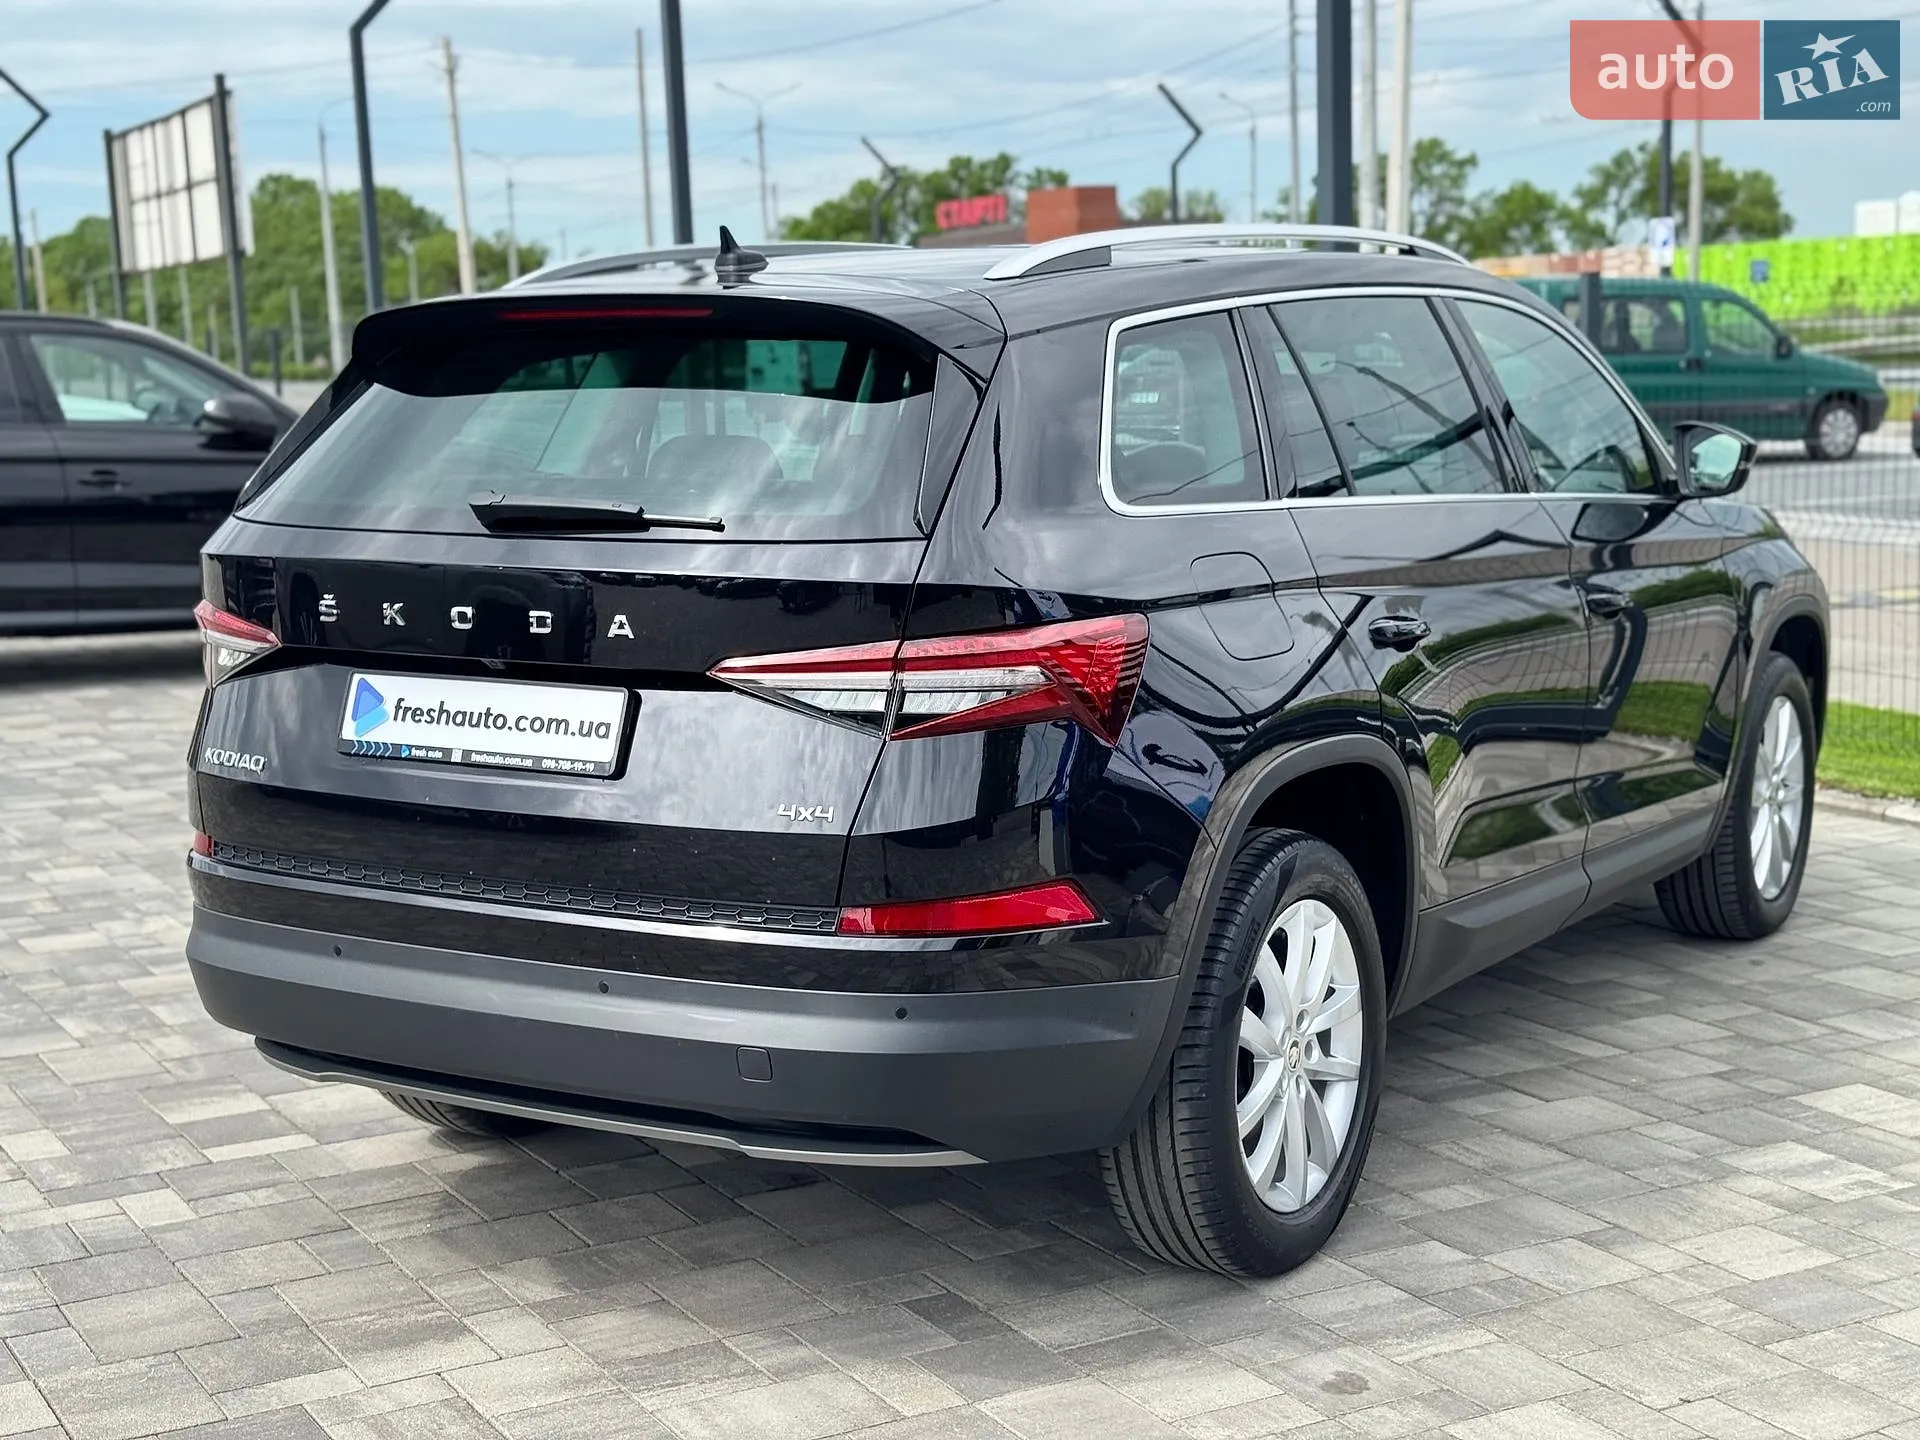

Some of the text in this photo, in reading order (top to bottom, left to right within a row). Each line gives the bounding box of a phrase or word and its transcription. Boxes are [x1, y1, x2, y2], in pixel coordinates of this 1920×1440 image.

[318, 593, 635, 639] ŠKODA
[393, 698, 611, 739] freshauto.com.ua
[205, 747, 265, 776] KODIAQ
[471, 752, 533, 767] freshauto.com.ua
[777, 803, 835, 823] 4x4
